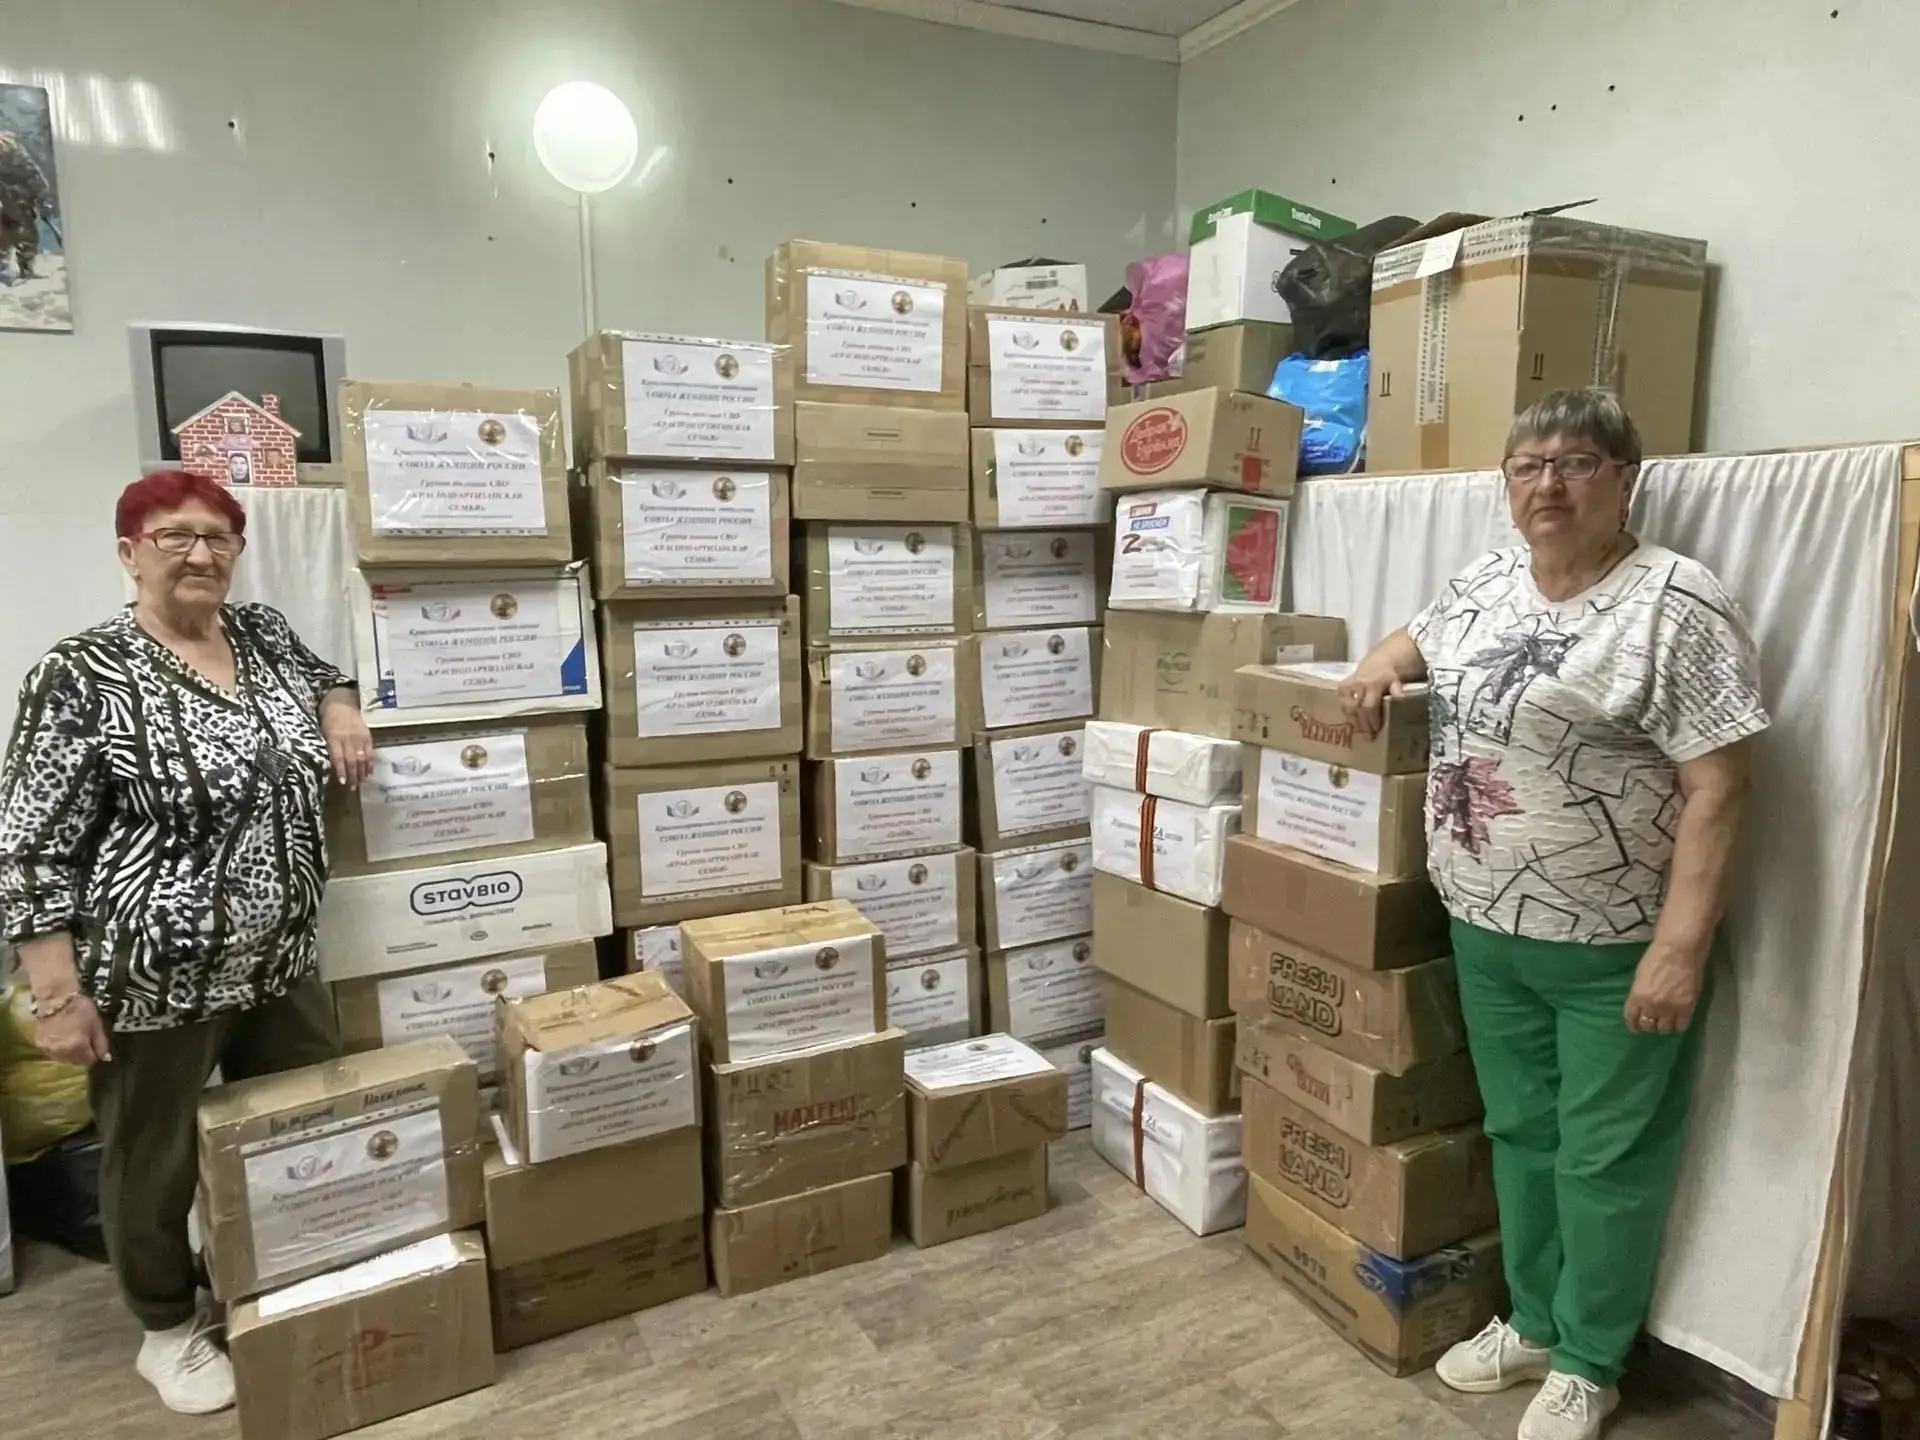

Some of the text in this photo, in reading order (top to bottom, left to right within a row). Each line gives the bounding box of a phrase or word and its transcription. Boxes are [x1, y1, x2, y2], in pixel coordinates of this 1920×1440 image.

[1270, 952, 1338, 998] FRESH
[1268, 980, 1336, 1030] LAND
[1280, 1116, 1346, 1170] FRESH
[1278, 1144, 1344, 1200] LAND
